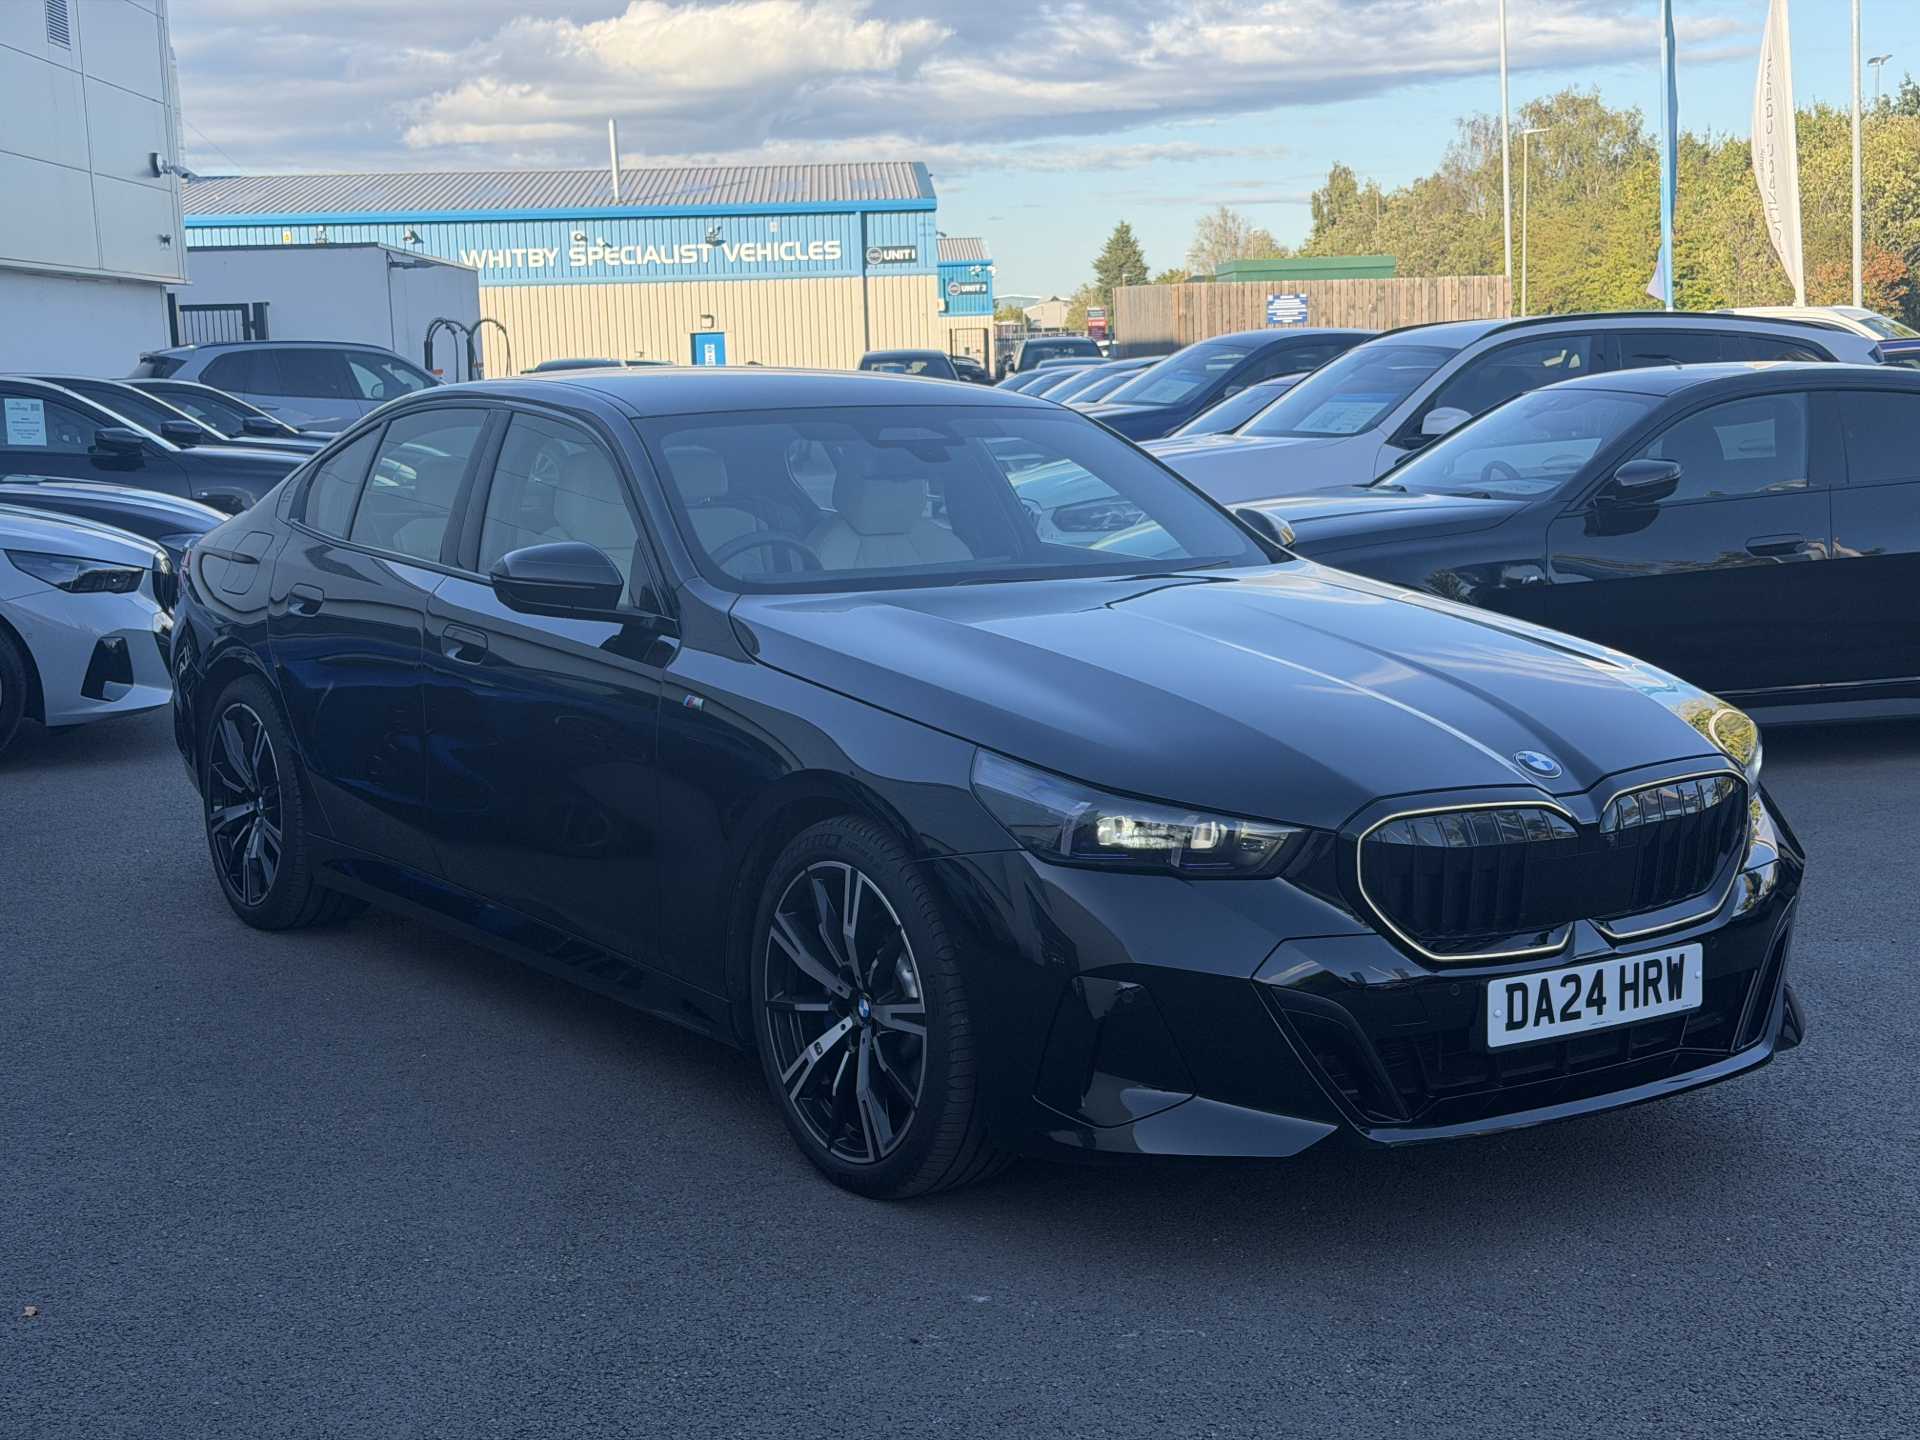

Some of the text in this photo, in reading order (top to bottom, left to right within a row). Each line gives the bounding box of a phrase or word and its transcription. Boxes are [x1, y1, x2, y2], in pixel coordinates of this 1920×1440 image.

[461, 247, 559, 269] WHITBY
[569, 243, 713, 267] SPECIALIST
[722, 240, 842, 263] VEHICLES
[883, 248, 911, 260] UNIT
[961, 284, 980, 292] UNIT
[1505, 953, 1686, 1032] DA24 HRW
